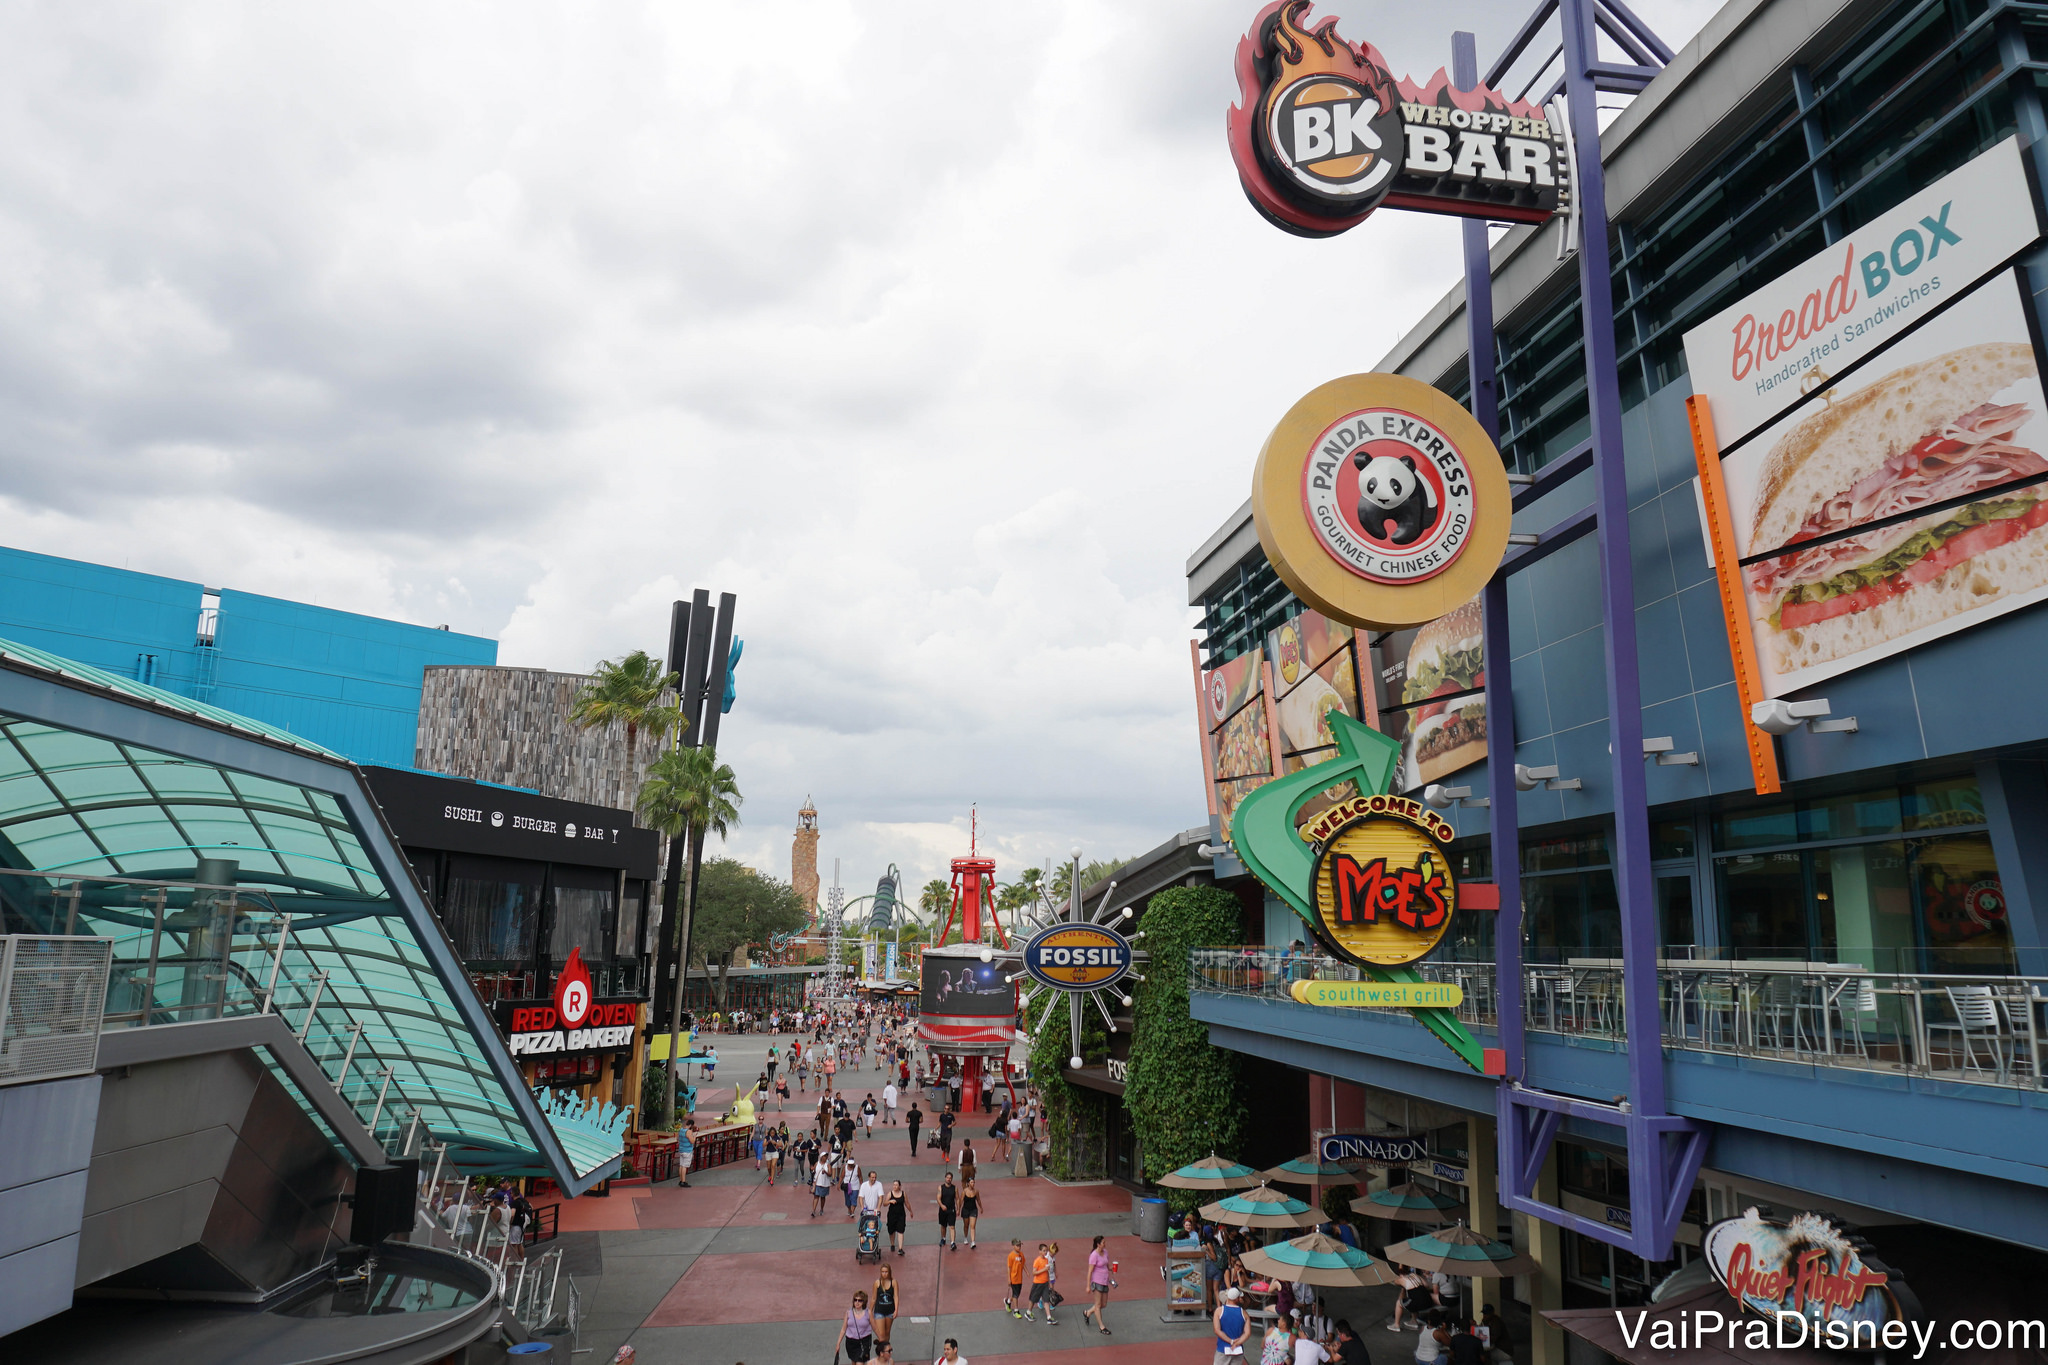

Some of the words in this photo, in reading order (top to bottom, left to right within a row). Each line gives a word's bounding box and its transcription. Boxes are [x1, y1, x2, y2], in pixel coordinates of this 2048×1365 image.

[1293, 98, 1382, 163] BK
[1400, 100, 1551, 141] WHOPPER
[1403, 123, 1555, 187] BAR
[1731, 242, 1858, 382] Bread
[1860, 199, 1963, 299] BOX
[1755, 334, 1841, 397] Handcrafted
[1844, 275, 1942, 343] Sandwiches
[1312, 419, 1375, 491] PANDA
[1382, 416, 1469, 497] EXPRESS
[1317, 504, 1375, 567] GOURMET
[1379, 550, 1442, 574] CHINESE
[1440, 512, 1467, 554] FOOD
[444, 805, 483, 823] SUSHI
[512, 815, 557, 834] BURGER
[1311, 796, 1423, 841] WELCOME
[1427, 810, 1454, 842] TO
[583, 826, 604, 840] BAR
[1046, 930, 1113, 946] AUTHENTIC
[1039, 948, 1123, 965] FOSSIL
[568, 991, 581, 1013] R
[1319, 985, 1408, 1002] southwest
[1414, 986, 1451, 1005] grill
[512, 1007, 557, 1031] RED
[590, 1003, 637, 1025] OVEN
[509, 1031, 566, 1056] PIZZA
[567, 1025, 635, 1050] BAKERY
[1323, 1138, 1428, 1162] CINNABON
[1727, 1242, 1793, 1312] Quiet
[1794, 1248, 1887, 1322] Flight
